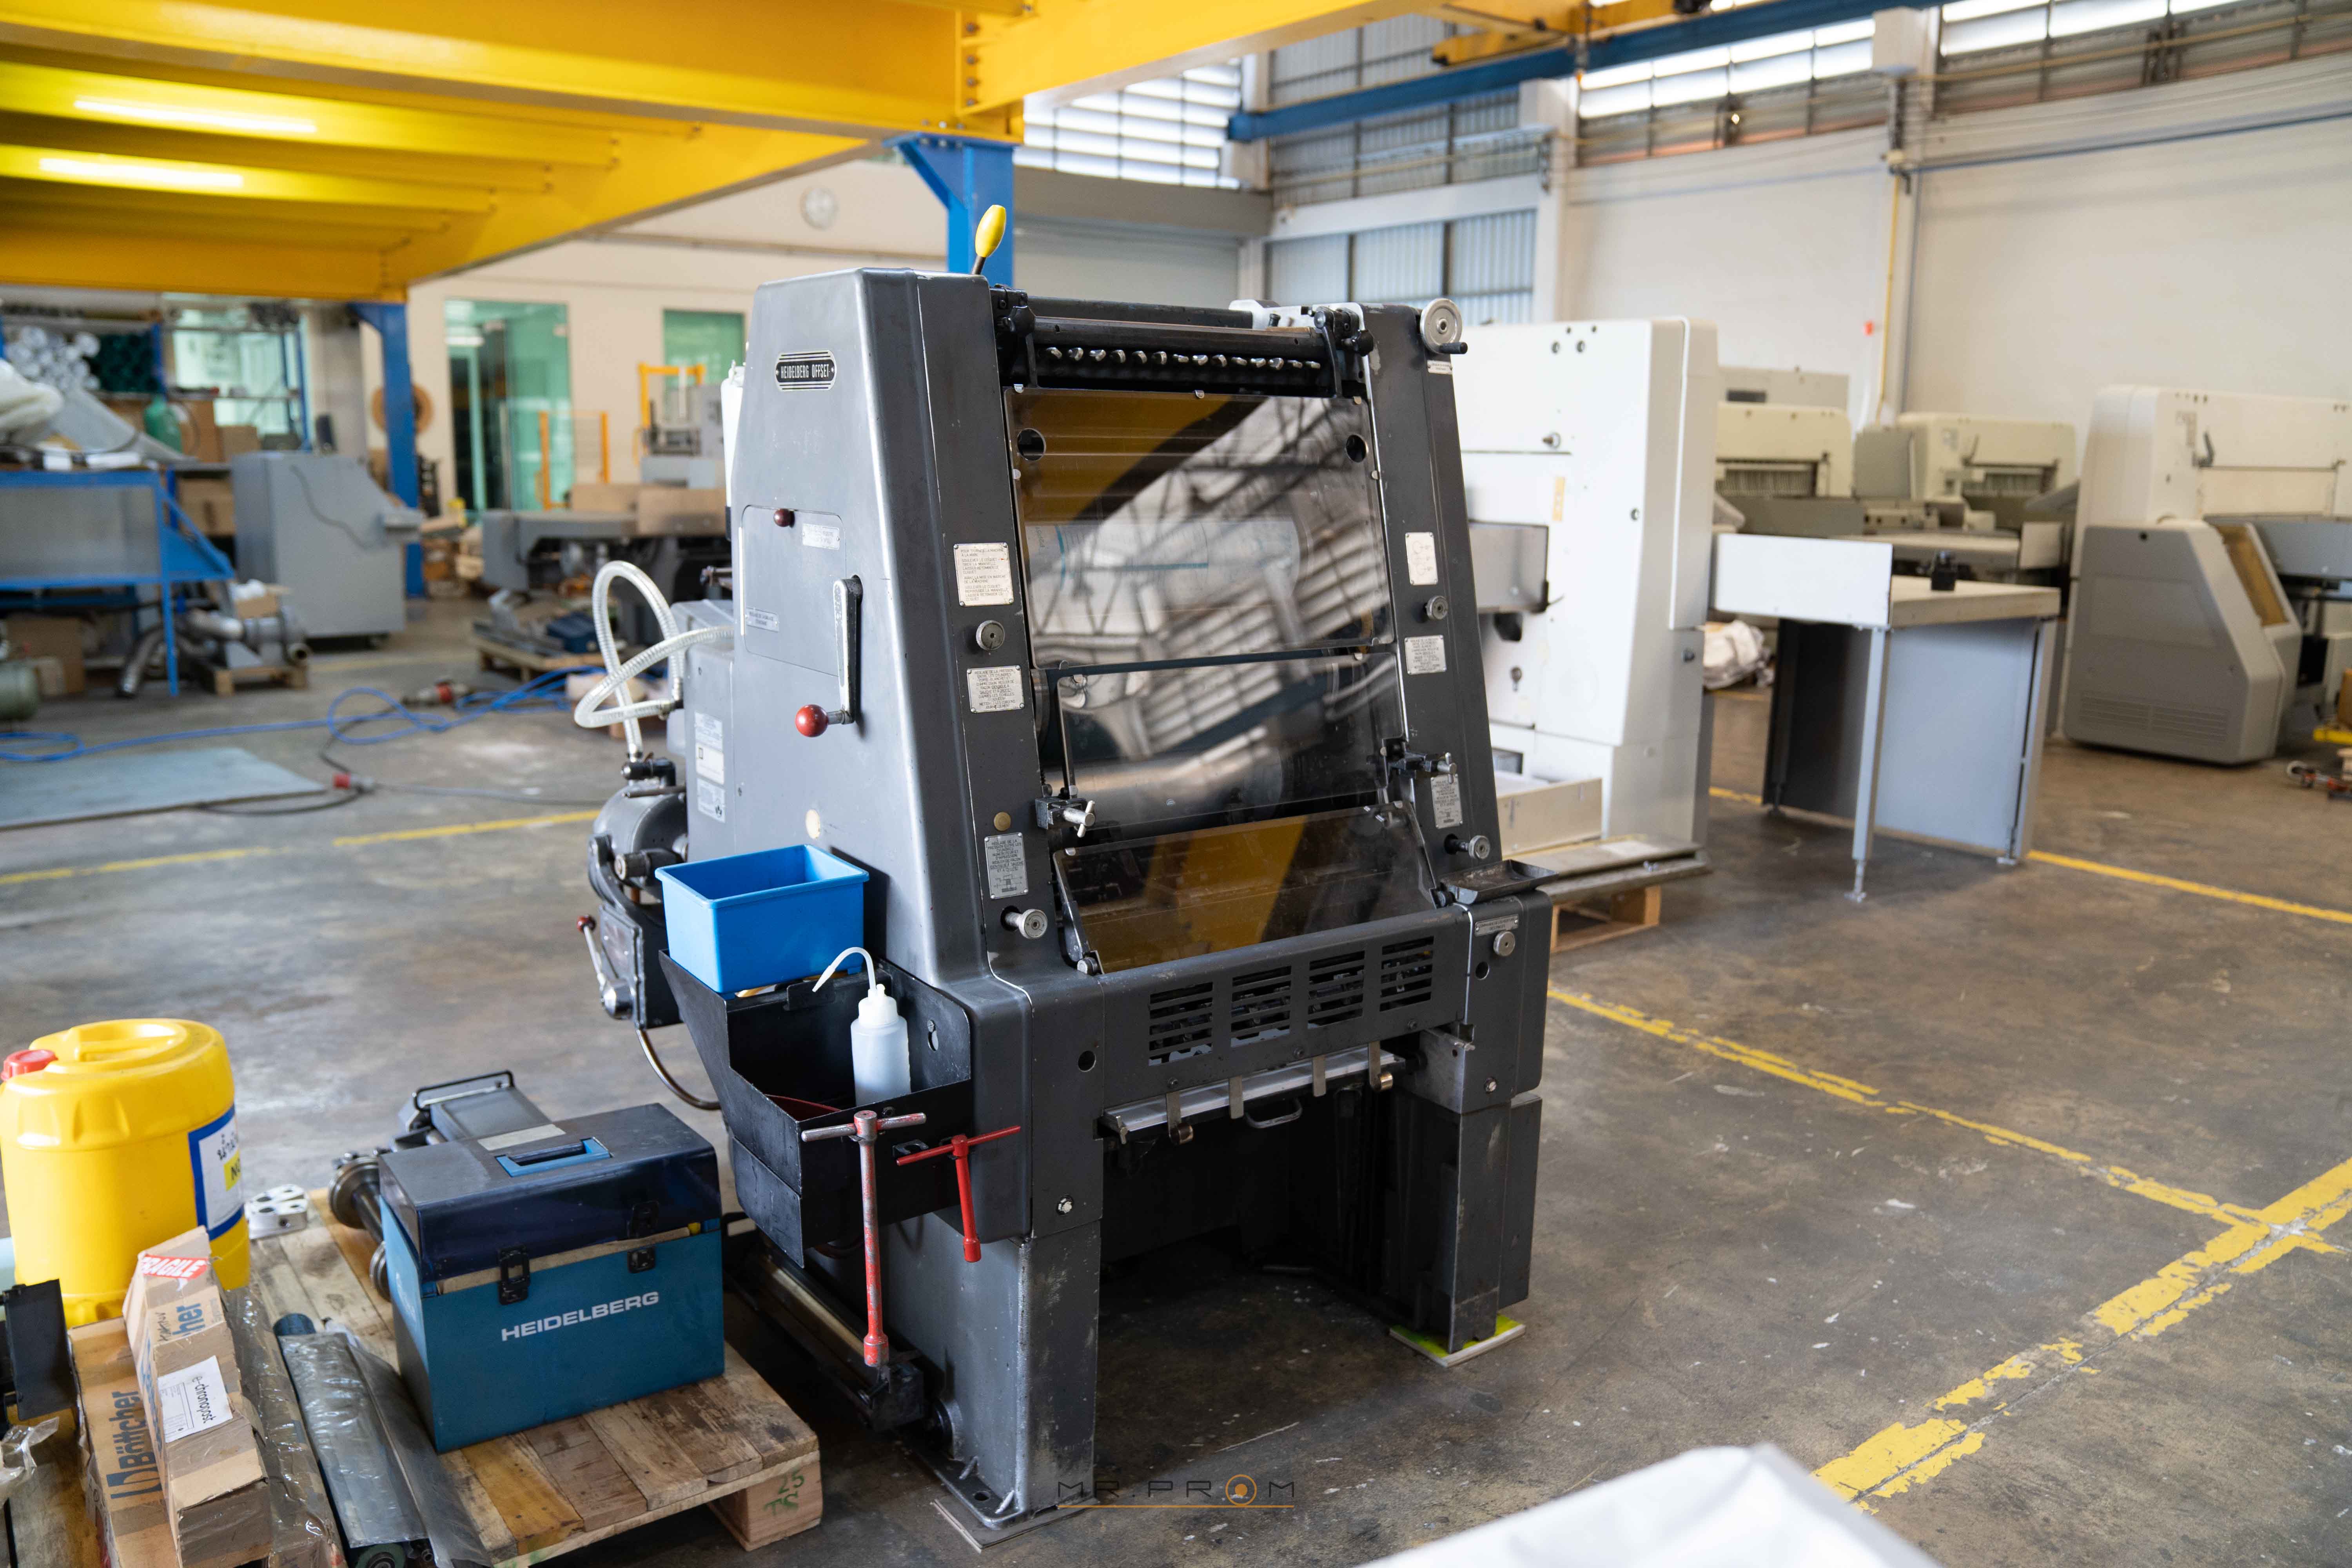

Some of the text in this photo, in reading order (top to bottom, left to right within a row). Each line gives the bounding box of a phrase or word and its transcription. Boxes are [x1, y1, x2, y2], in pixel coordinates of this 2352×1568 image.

[780, 364, 829, 379] HEIDELBERG OFFSET
[142, 1257, 207, 1277] FRAGILE
[172, 1303, 205, 1335] her
[501, 1291, 660, 1341] HEIDELBERG
[192, 1376, 216, 1424] e-chronopost
[109, 1390, 156, 1470] Böttcher
